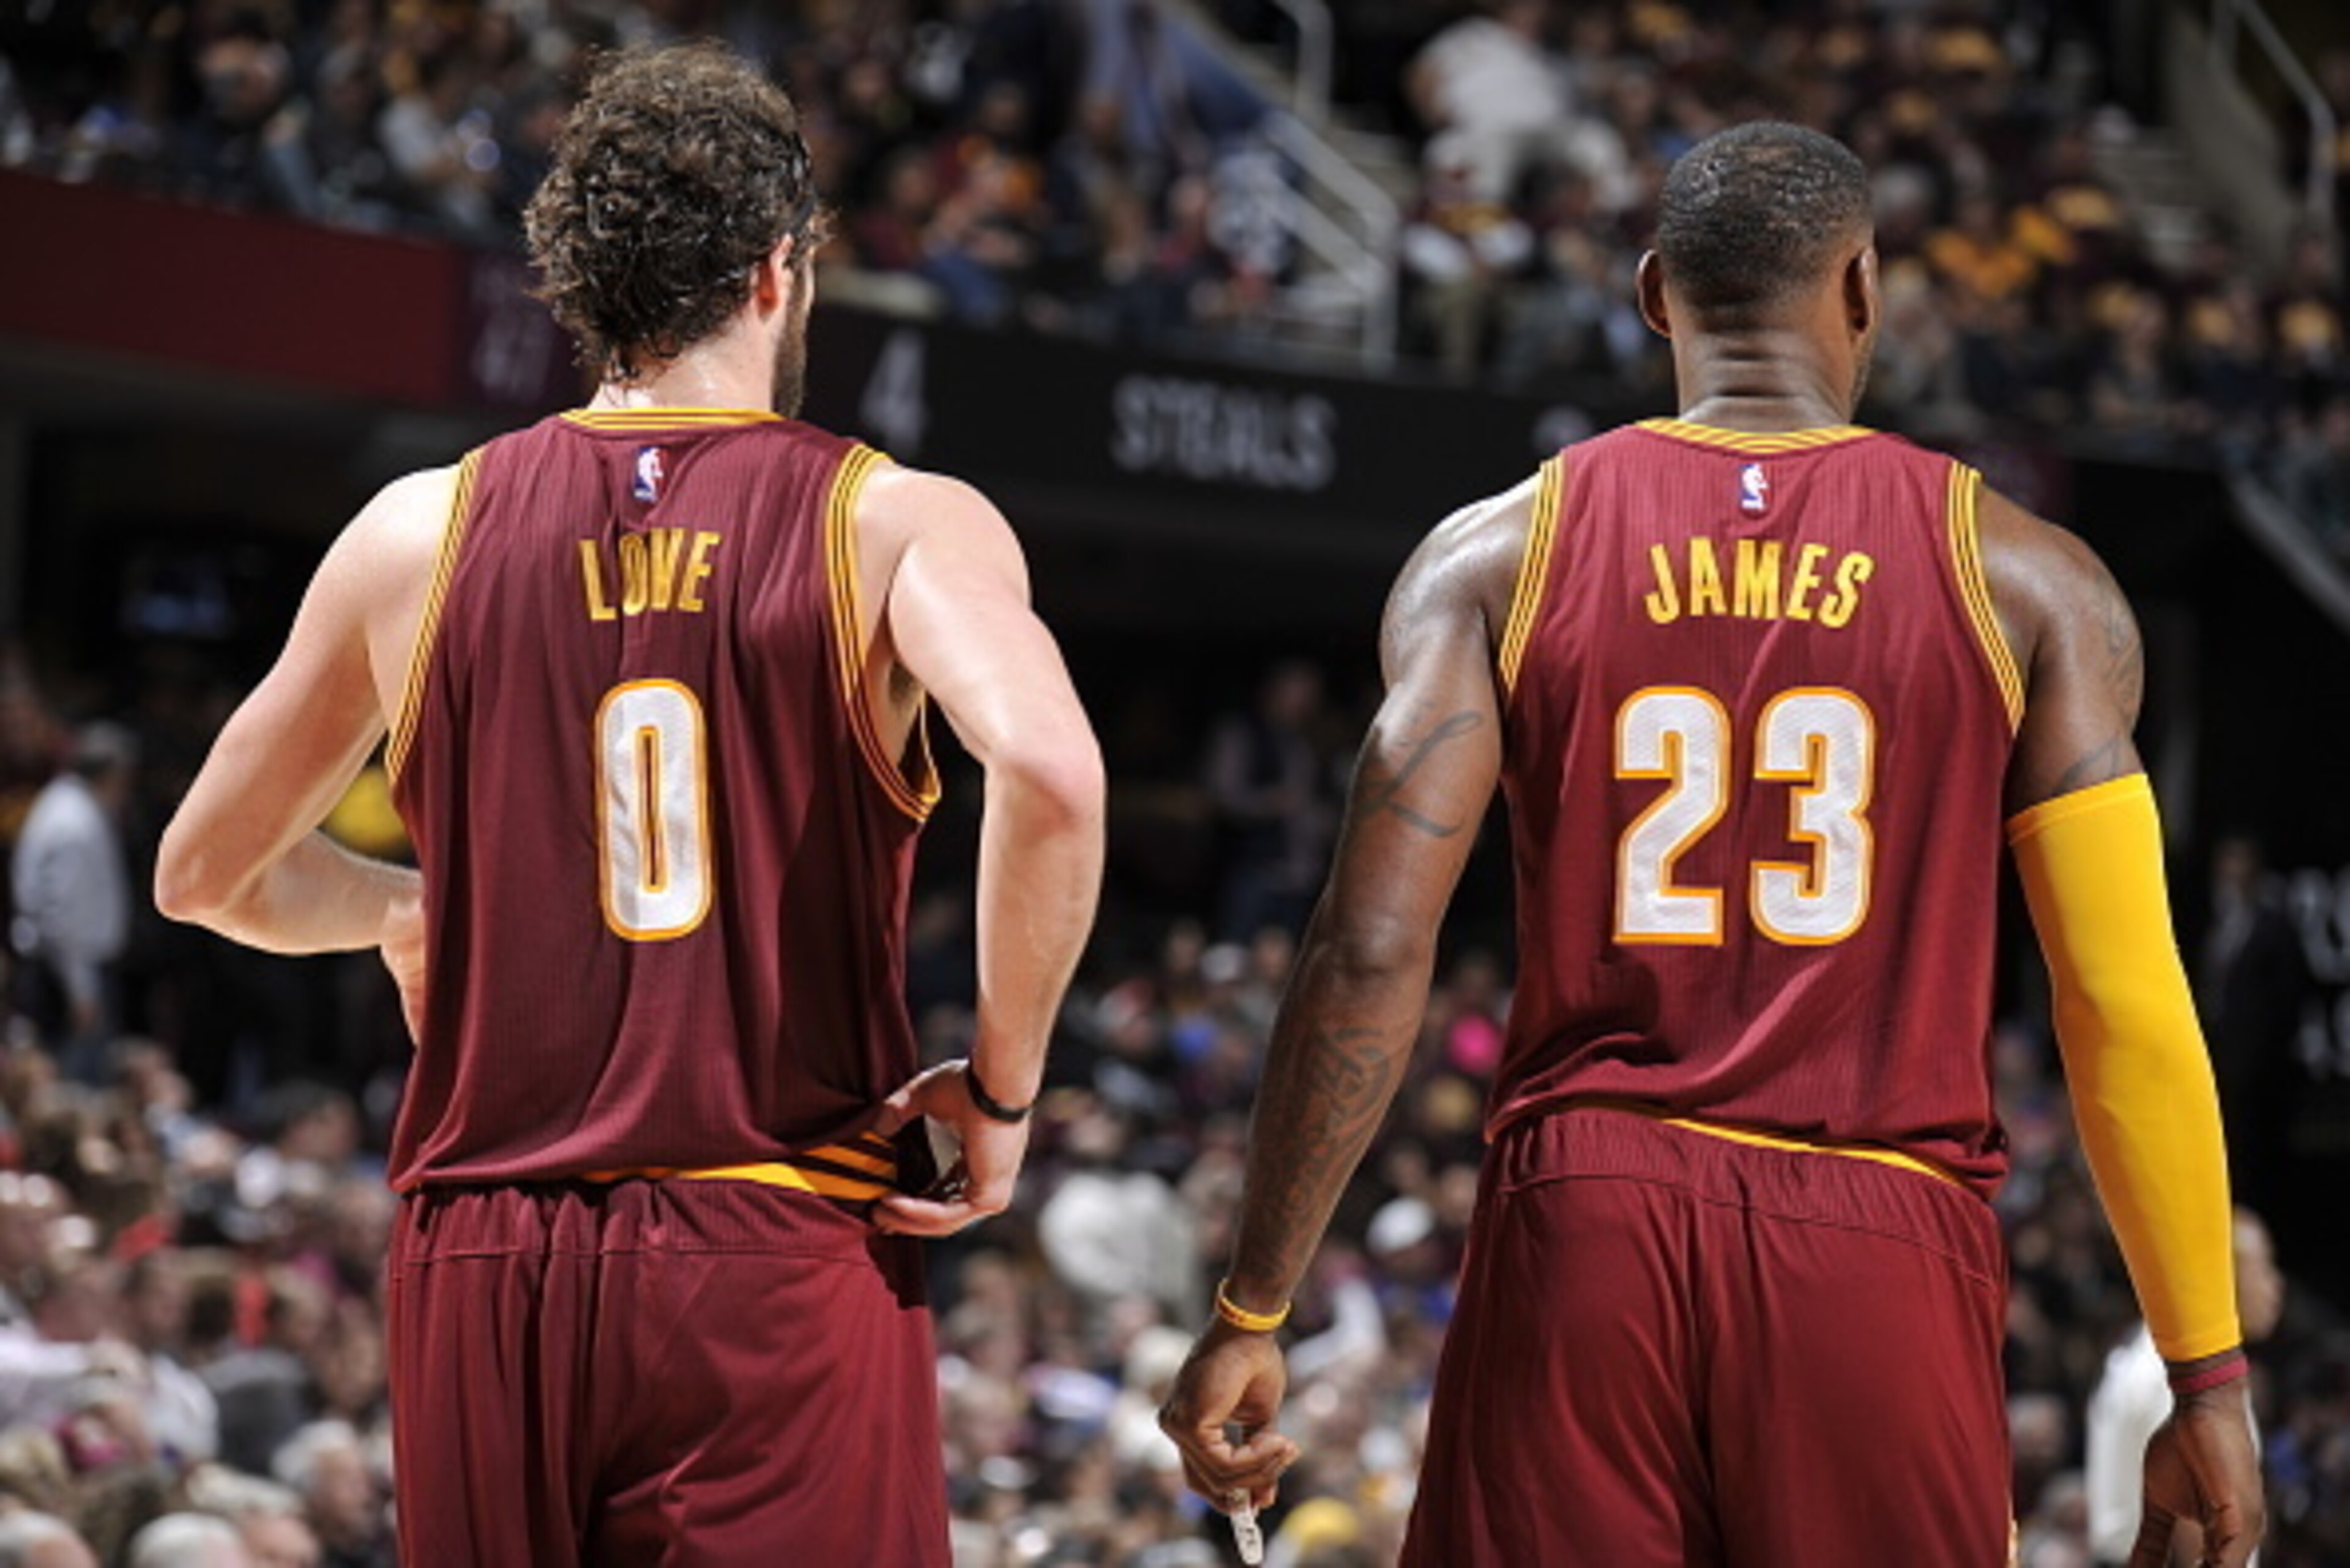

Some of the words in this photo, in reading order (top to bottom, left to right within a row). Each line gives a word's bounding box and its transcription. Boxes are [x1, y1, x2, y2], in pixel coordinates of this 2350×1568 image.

[859, 327, 927, 459] 4
[1111, 373, 1338, 491] STEALS
[578, 527, 721, 621] LOVE
[1644, 536, 1874, 629] JAMES
[596, 678, 714, 941] 0
[1613, 685, 1874, 946] 23
